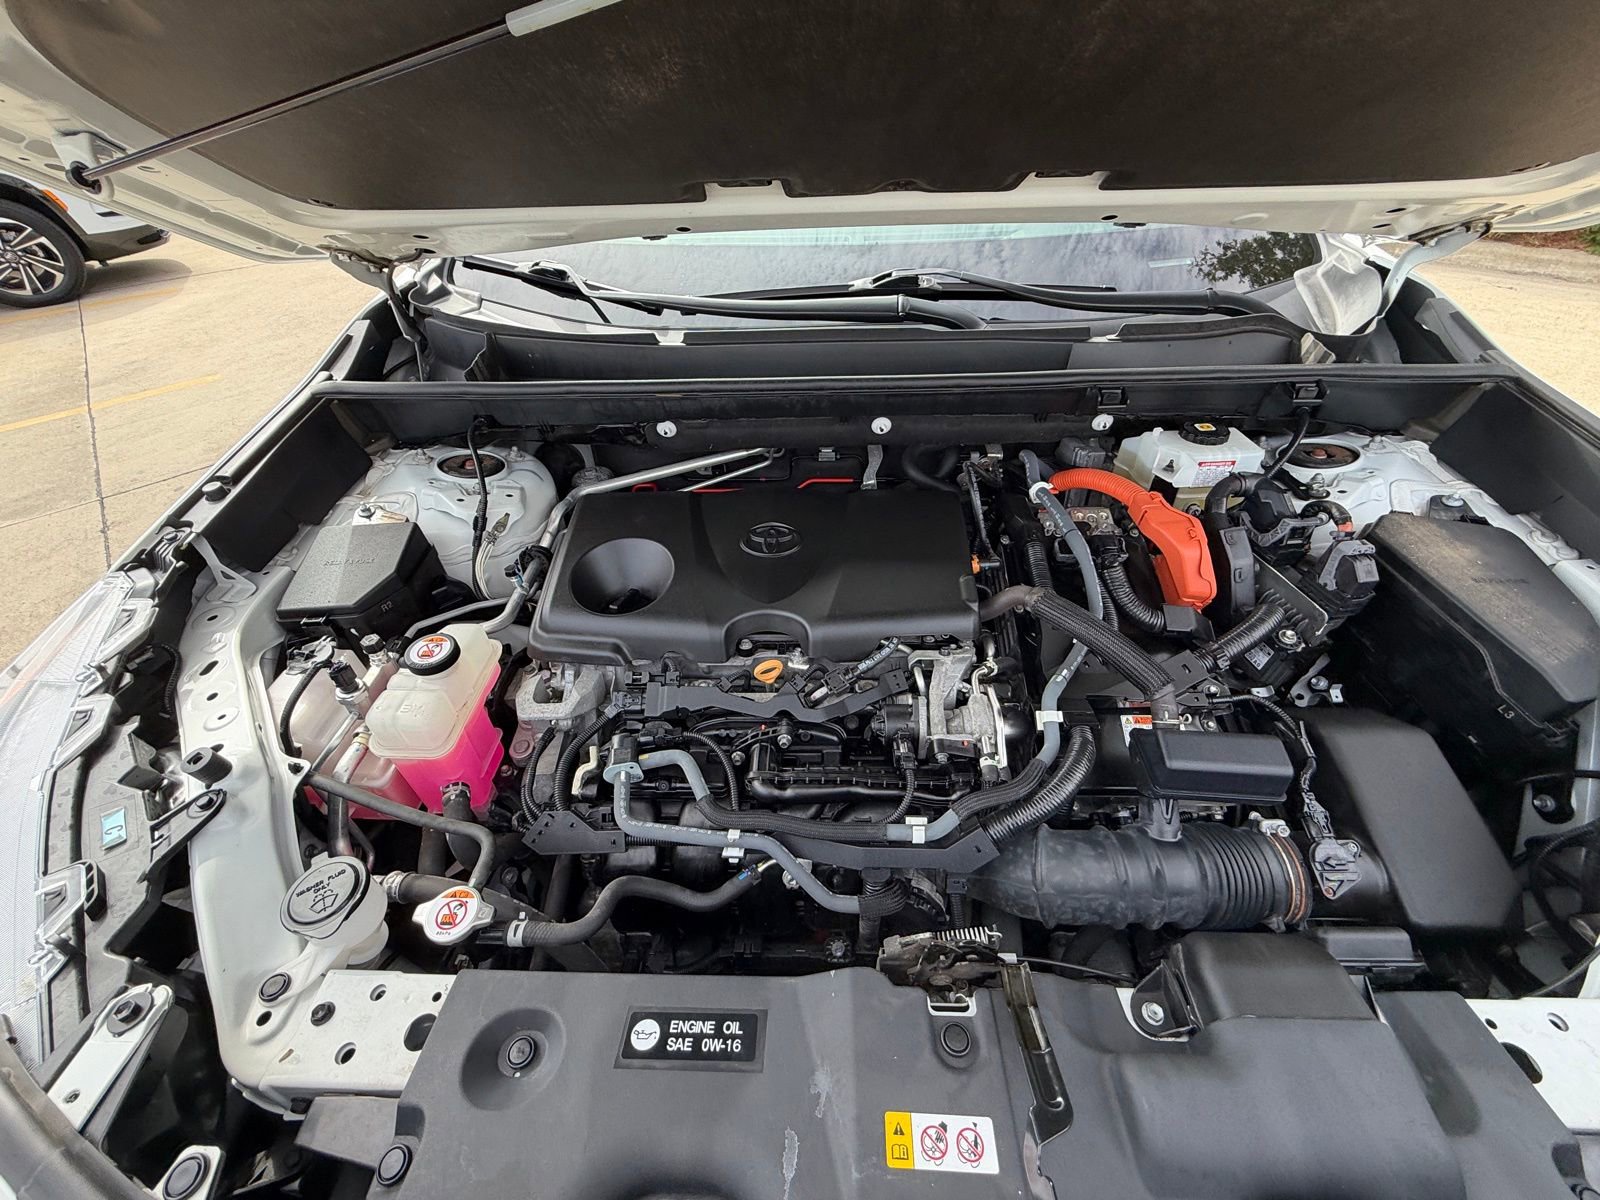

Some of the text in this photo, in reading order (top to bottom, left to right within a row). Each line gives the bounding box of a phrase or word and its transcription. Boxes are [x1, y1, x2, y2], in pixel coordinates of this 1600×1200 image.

[1497, 704, 1515, 719] L3
[295, 868, 347, 898] WASHER FLUID
[313, 881, 331, 894] ONLY
[669, 1020, 743, 1034] ENGINE OIL
[666, 1037, 742, 1052] SAE 0W-16
